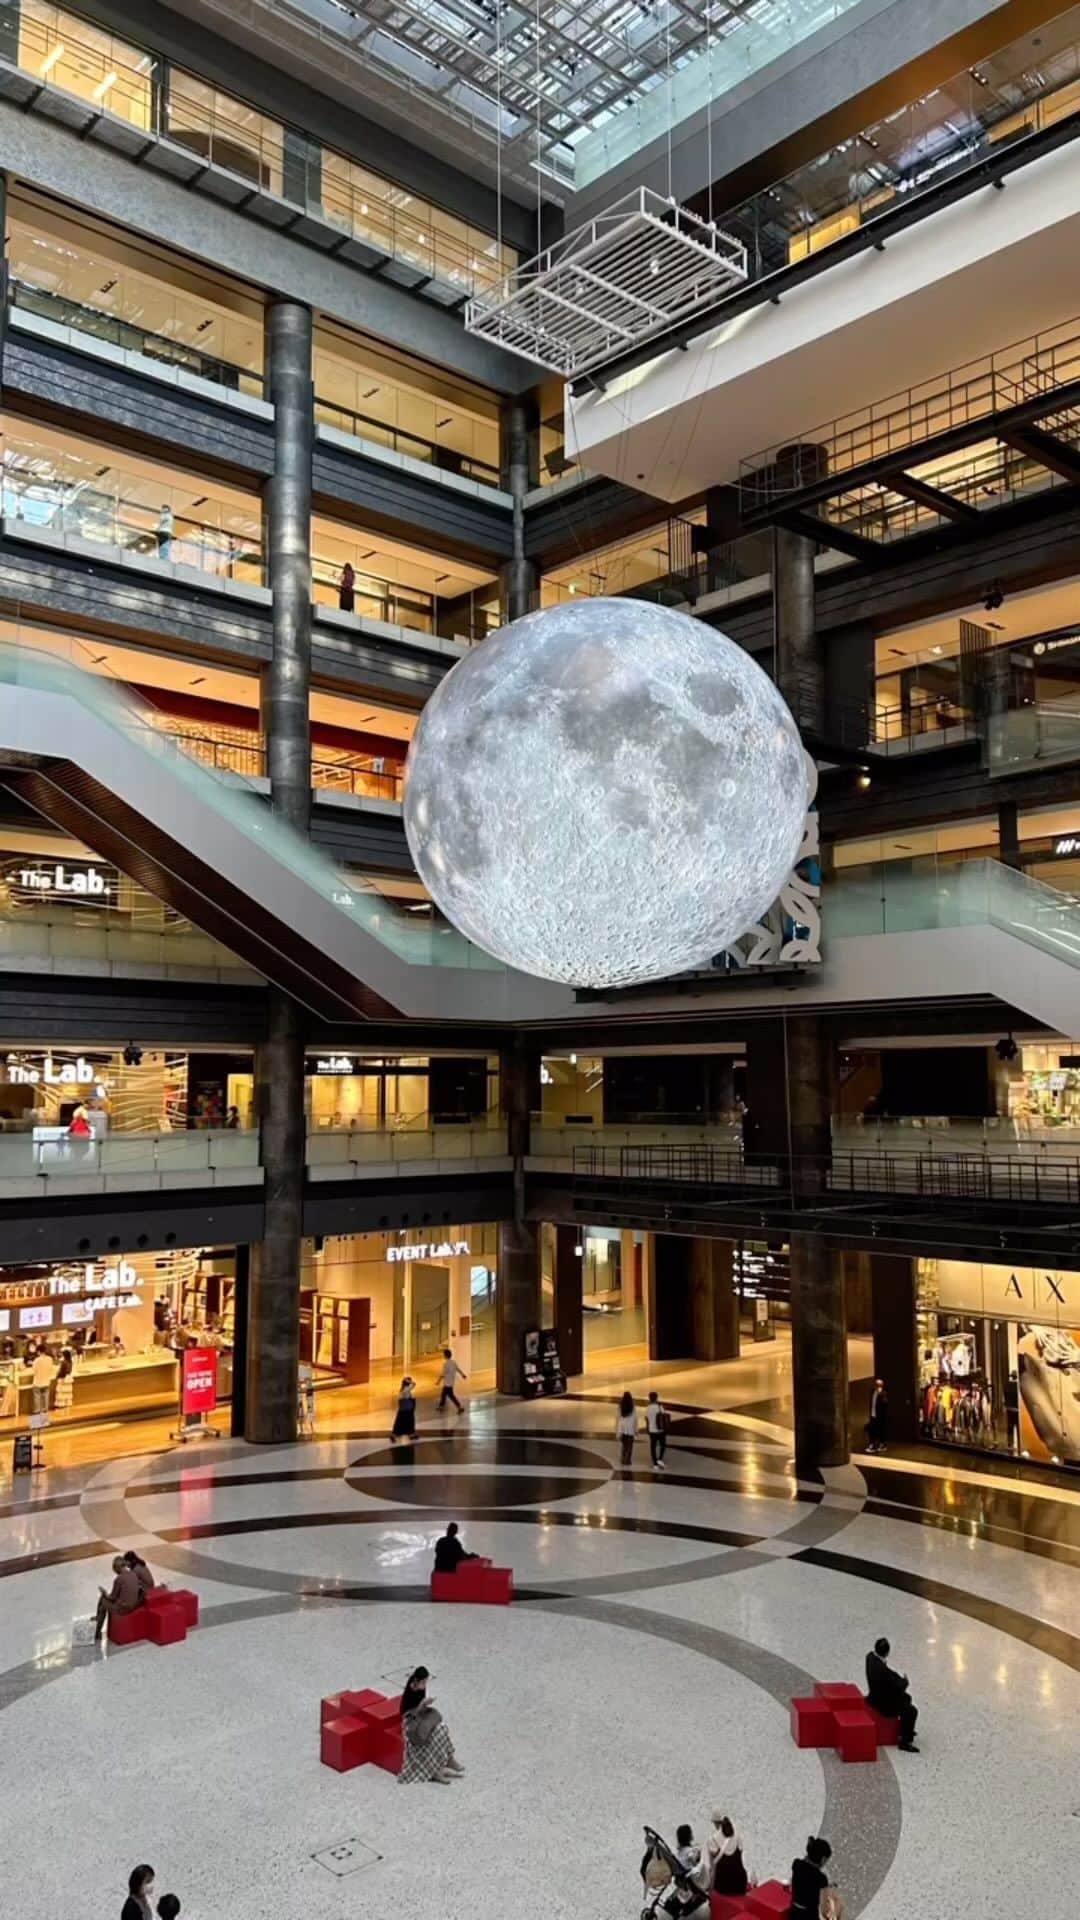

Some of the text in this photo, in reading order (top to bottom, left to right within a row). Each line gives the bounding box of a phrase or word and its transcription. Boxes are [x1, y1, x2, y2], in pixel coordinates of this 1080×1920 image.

[20, 870, 51, 889] The
[8, 1066, 40, 1083] The
[387, 1244, 428, 1262] EVENT
[48, 1276, 81, 1296] The
